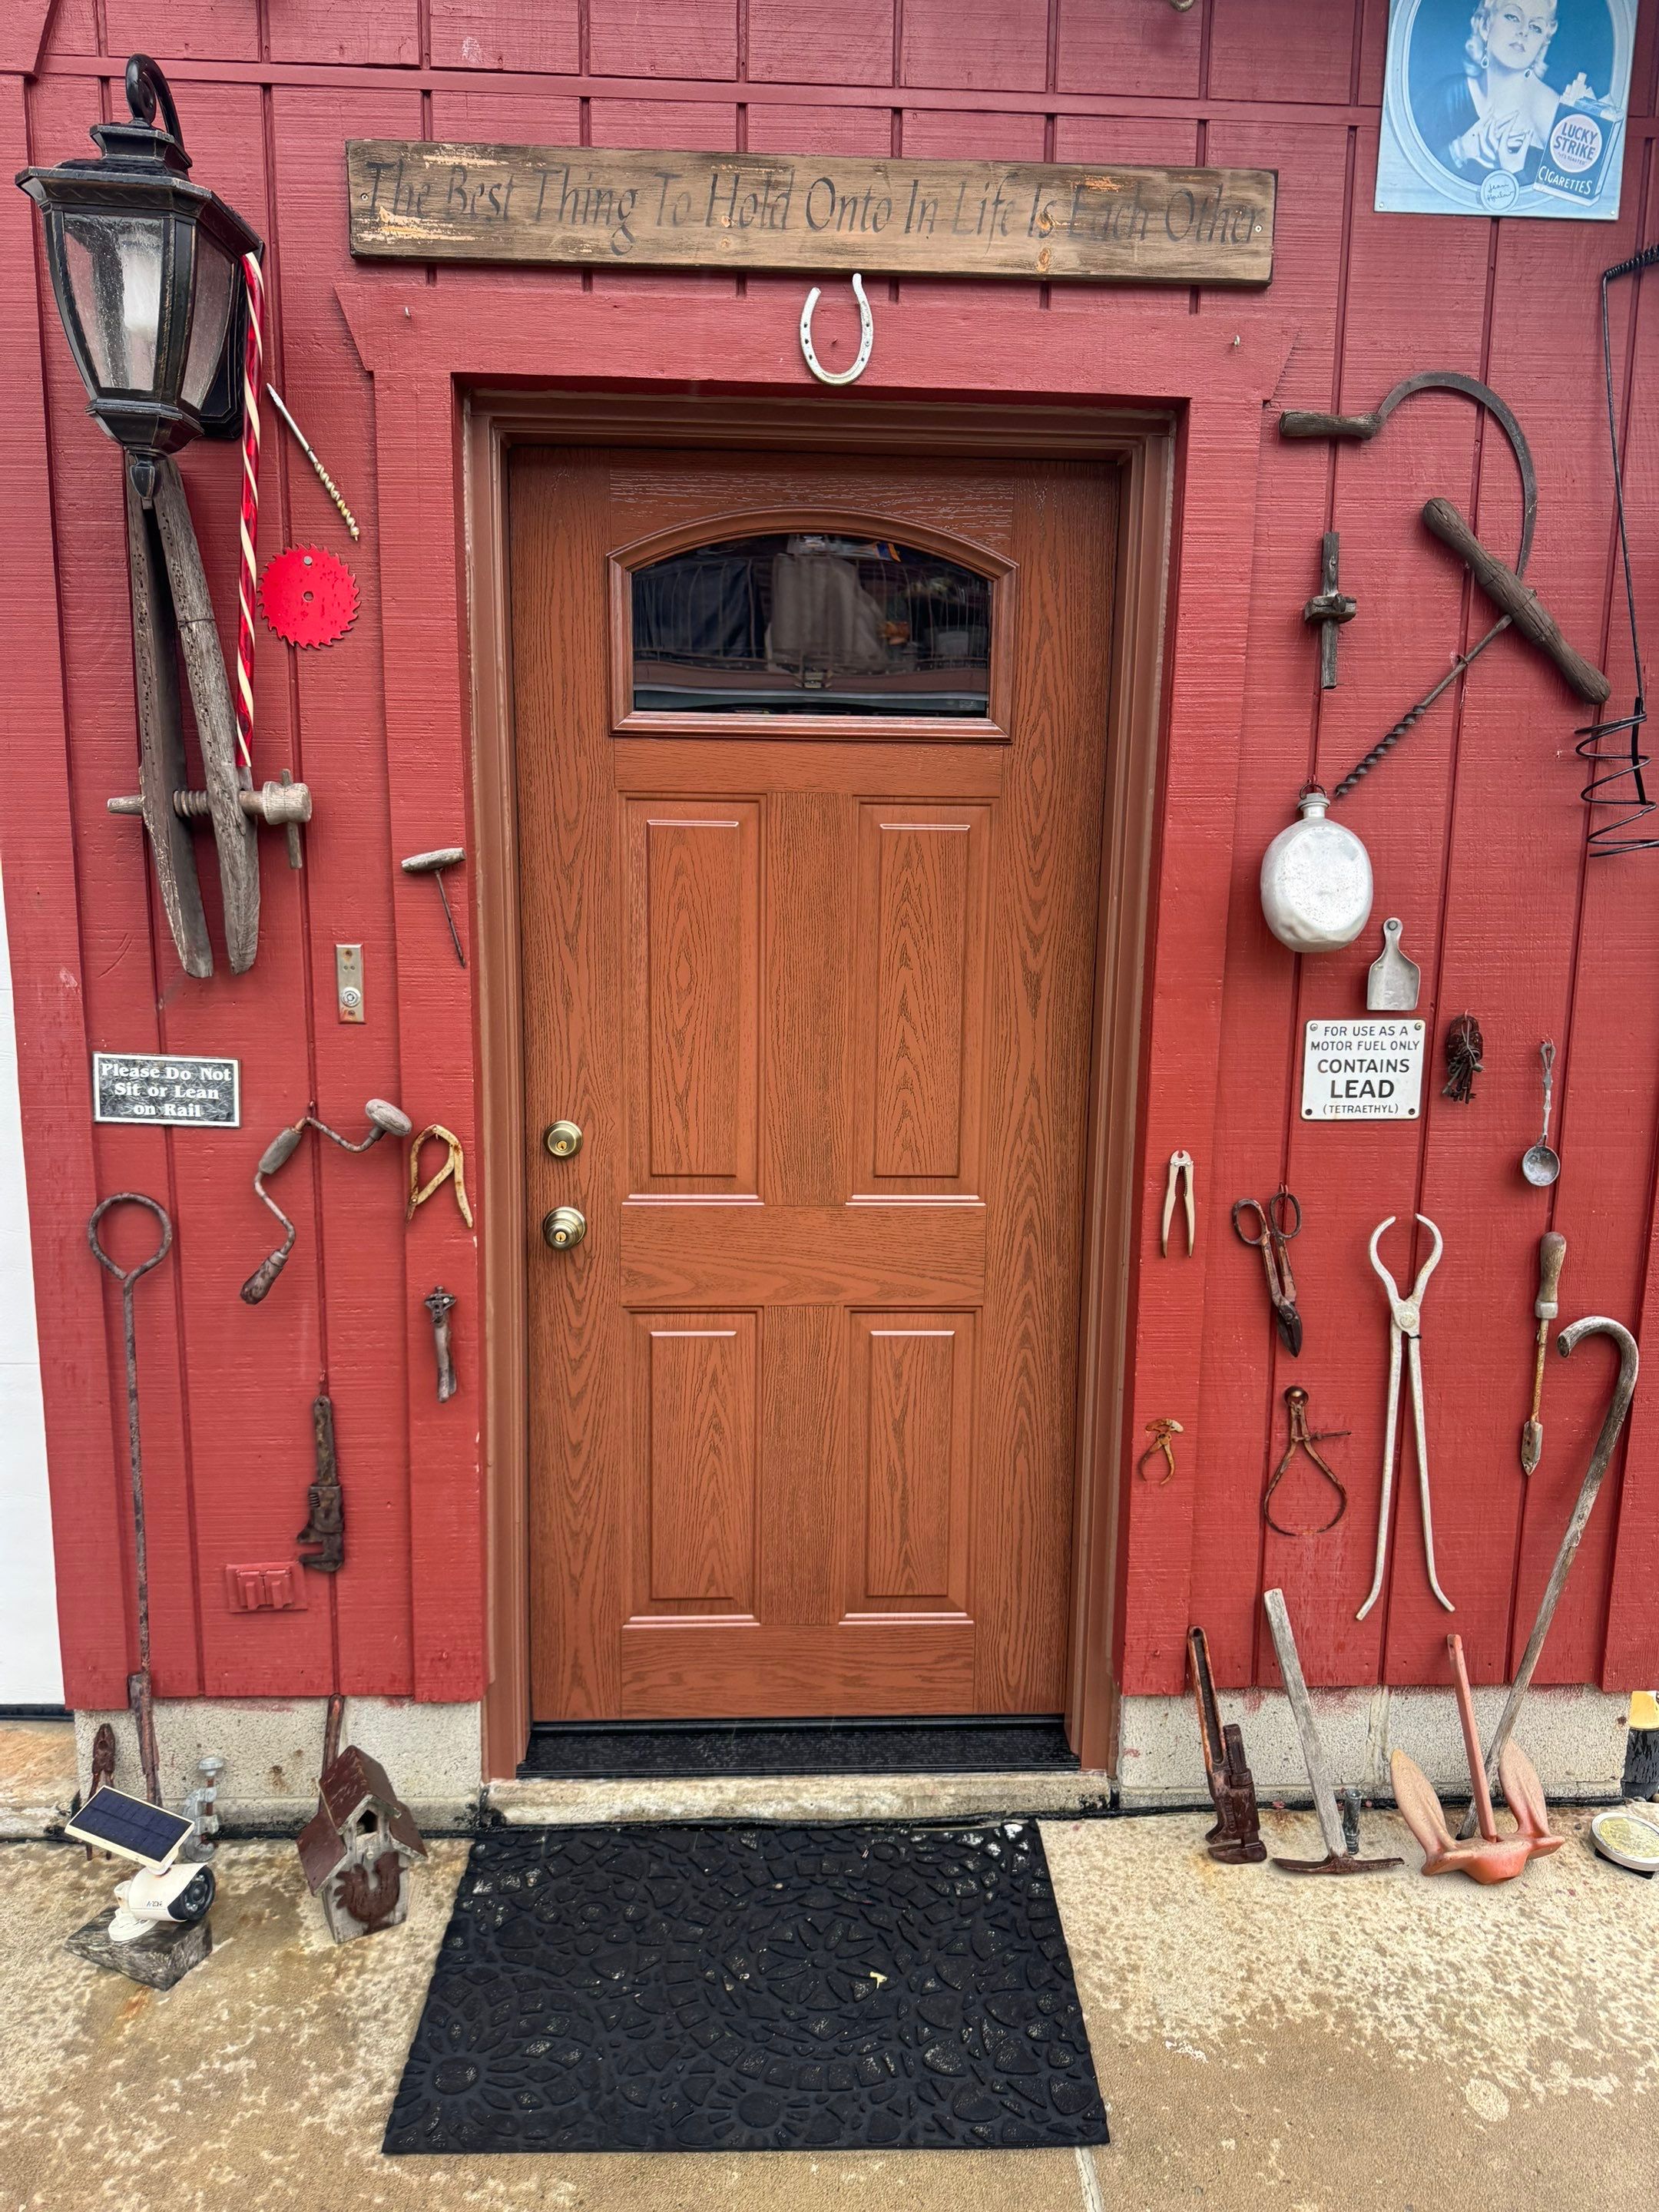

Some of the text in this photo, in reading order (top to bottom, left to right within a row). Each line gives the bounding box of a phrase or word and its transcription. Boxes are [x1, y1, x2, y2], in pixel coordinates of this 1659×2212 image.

[1561, 122, 1598, 145] LUCKY
[1554, 136, 1595, 161] STRIKE
[1538, 166, 1592, 194] CIGARETTES
[366, 159, 1265, 257] The Best Thing To Hold Onto In Life Is Each Other
[1324, 1026, 1409, 1036] FOR USE AS A
[1310, 1041, 1419, 1051] MOTOR FUEL ONLY
[100, 1063, 232, 1081] Please Do Not
[1317, 1058, 1409, 1074] CONTAINS
[114, 1082, 219, 1100] Sit or Lean
[1330, 1079, 1395, 1098] LEAD
[134, 1104, 201, 1118] on Rail
[1323, 1103, 1399, 1114] (TETRAETHYL)
